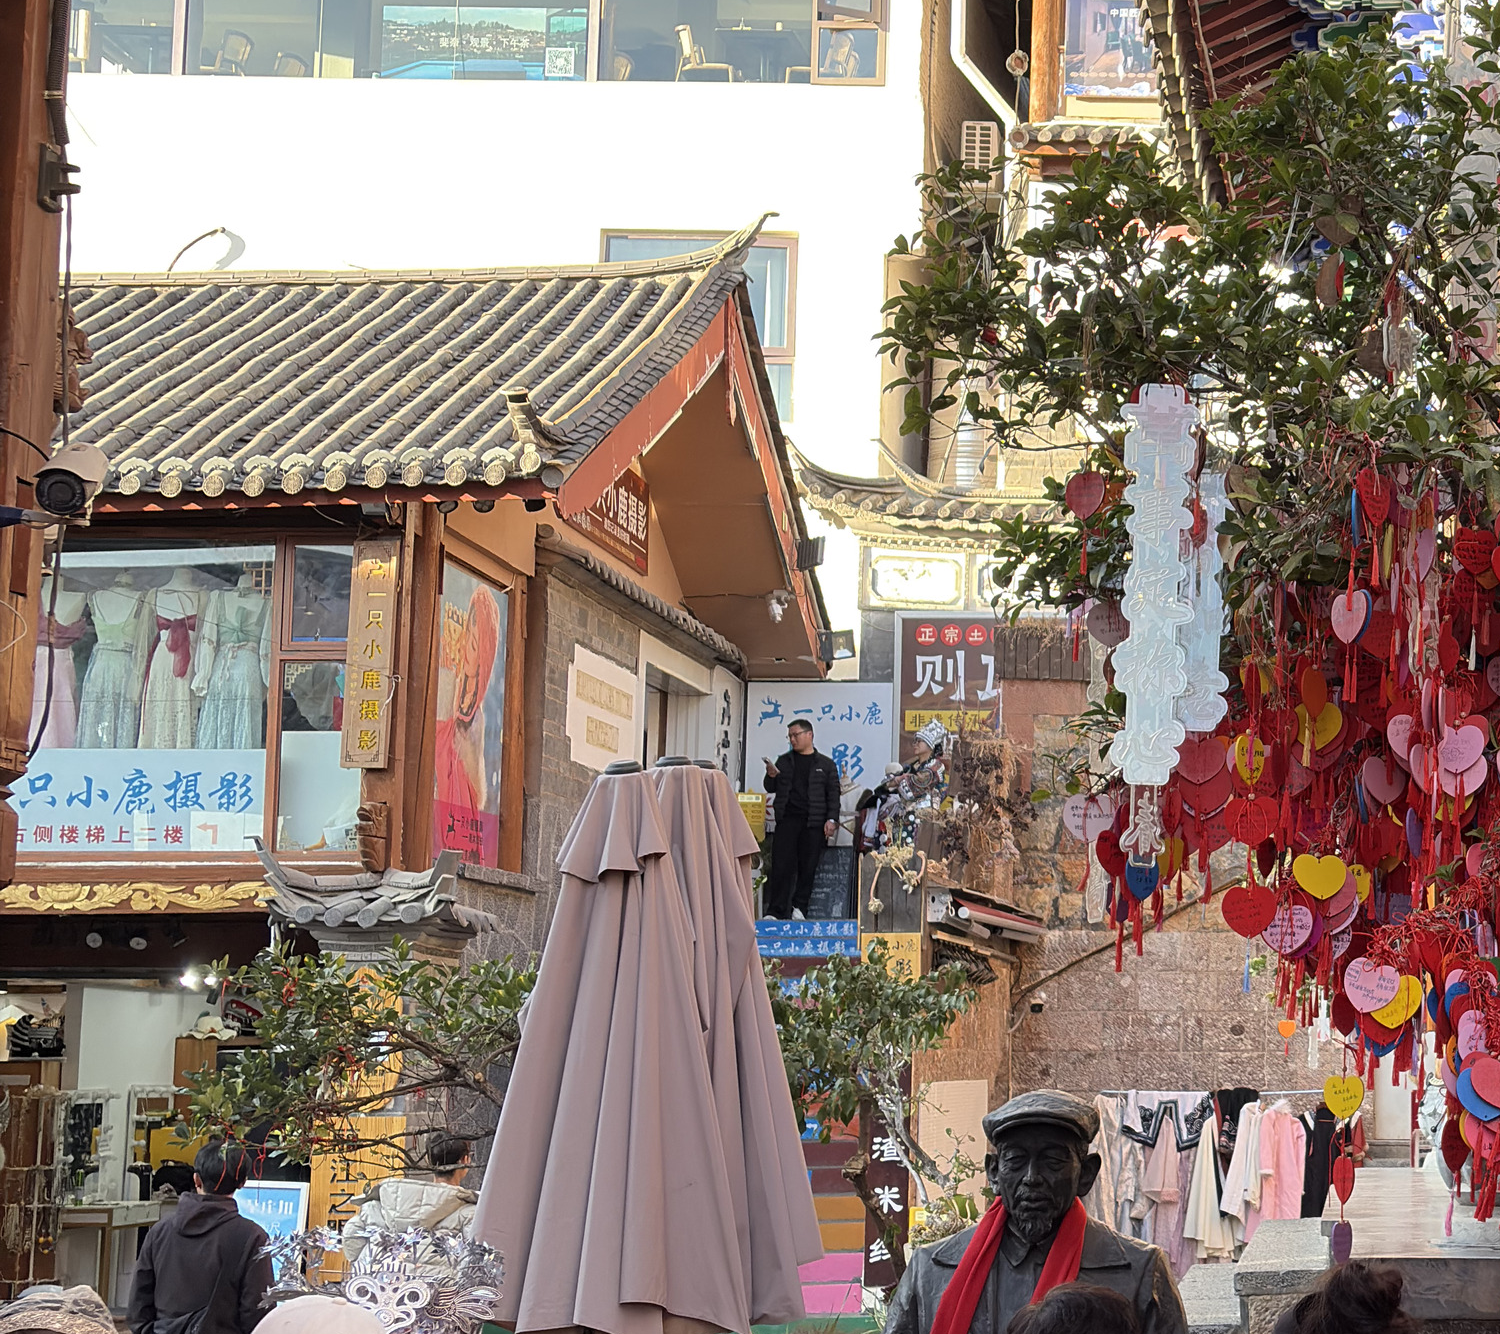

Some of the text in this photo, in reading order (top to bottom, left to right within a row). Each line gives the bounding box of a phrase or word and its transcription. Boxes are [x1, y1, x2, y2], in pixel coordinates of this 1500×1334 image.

[917, 626, 984, 644] 正宗土
[357, 591, 388, 751] 一只小鹿摄影
[793, 701, 884, 725] 一只小鹿
[19, 767, 254, 816] 只小鹿摄影
[765, 922, 855, 937] 一只小鹿摄影
[758, 938, 847, 954] 一只小鹿摄影
